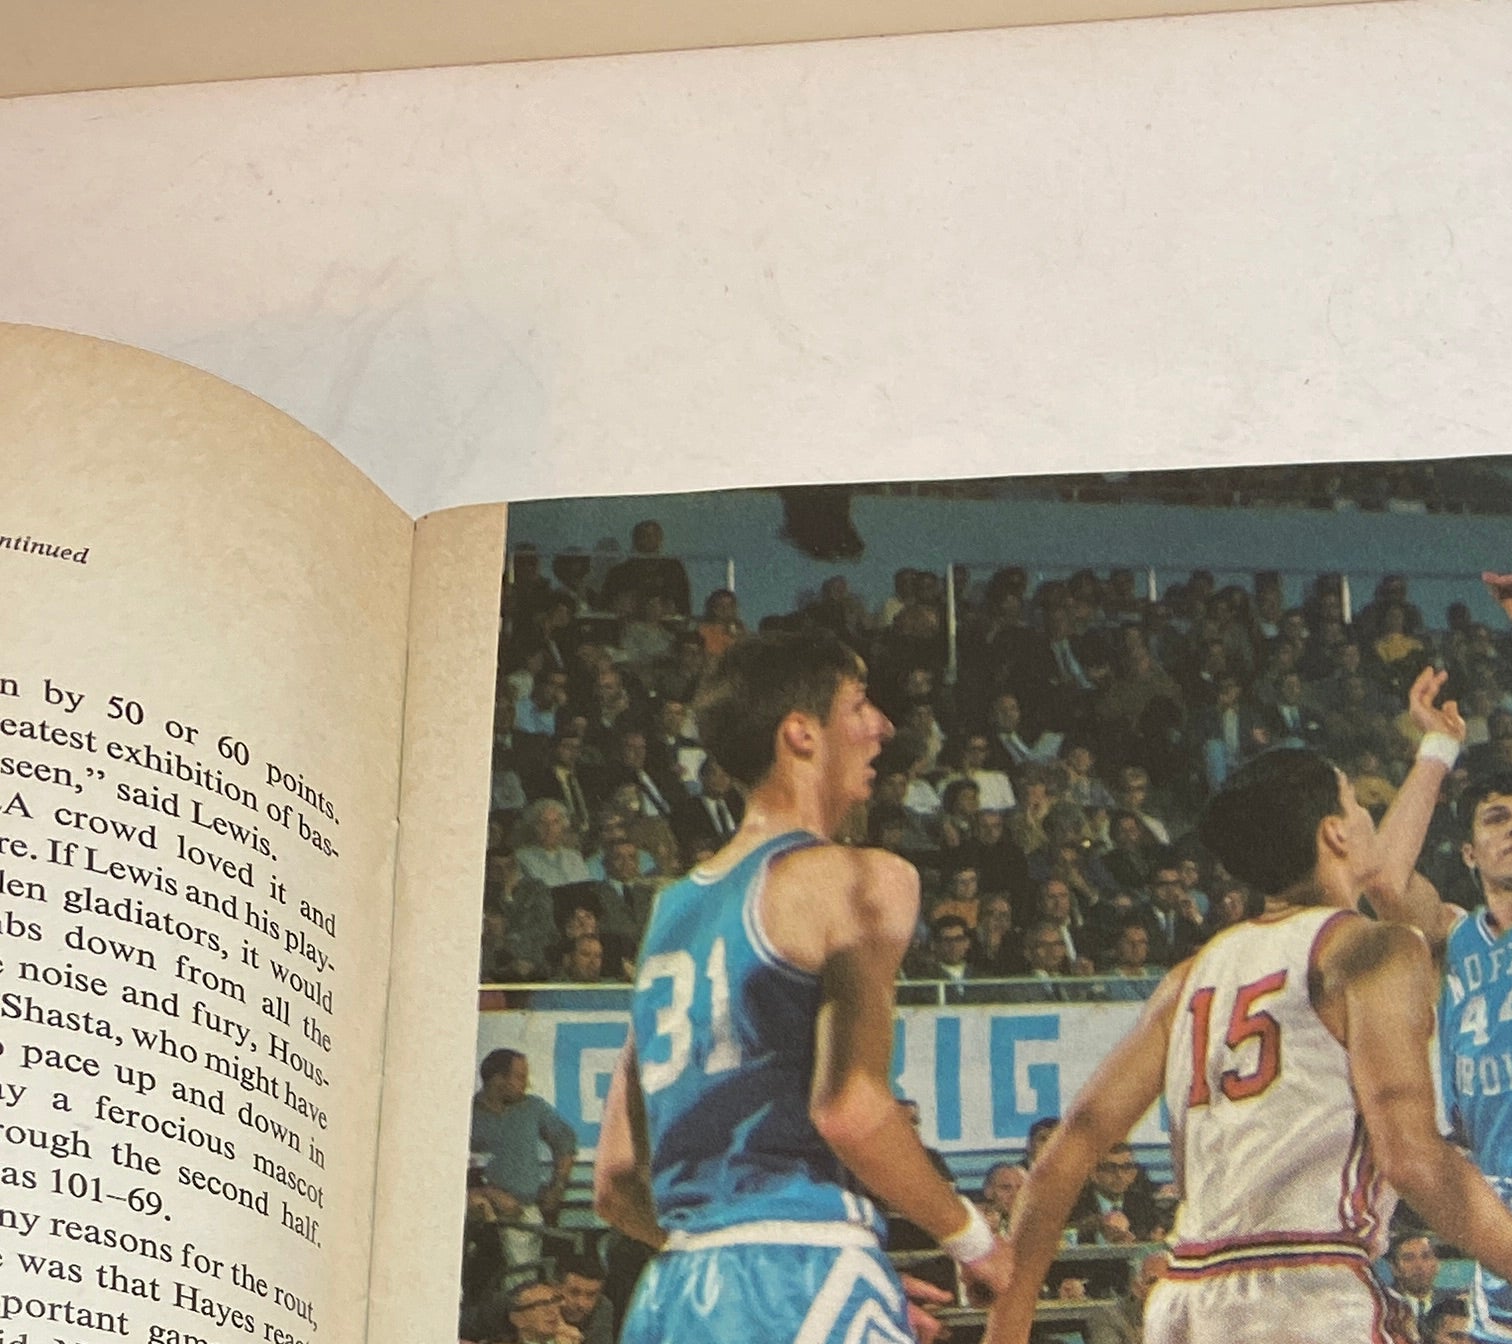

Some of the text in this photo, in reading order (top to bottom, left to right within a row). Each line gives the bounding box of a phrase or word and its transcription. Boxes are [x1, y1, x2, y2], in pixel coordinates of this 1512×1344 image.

[44, 679, 339, 825] by 50 or 60 points.
[54, 808, 335, 938] crowd loved it and
[117, 783, 180, 818] said
[191, 799, 277, 861] Lewis.
[63, 887, 333, 1015] gladiators, it would
[18, 962, 329, 1086] noise and fury, Hous-
[636, 936, 744, 1095] 31
[1184, 968, 1290, 1109] 15
[20, 1045, 324, 1169] pace up and down in
[111, 1143, 320, 1248] the second half.
[17, 1253, 82, 1283] was
[96, 1265, 160, 1302] that
[173, 1282, 255, 1333] Hayes
[49, 1218, 317, 1332] reasons for the rout,
